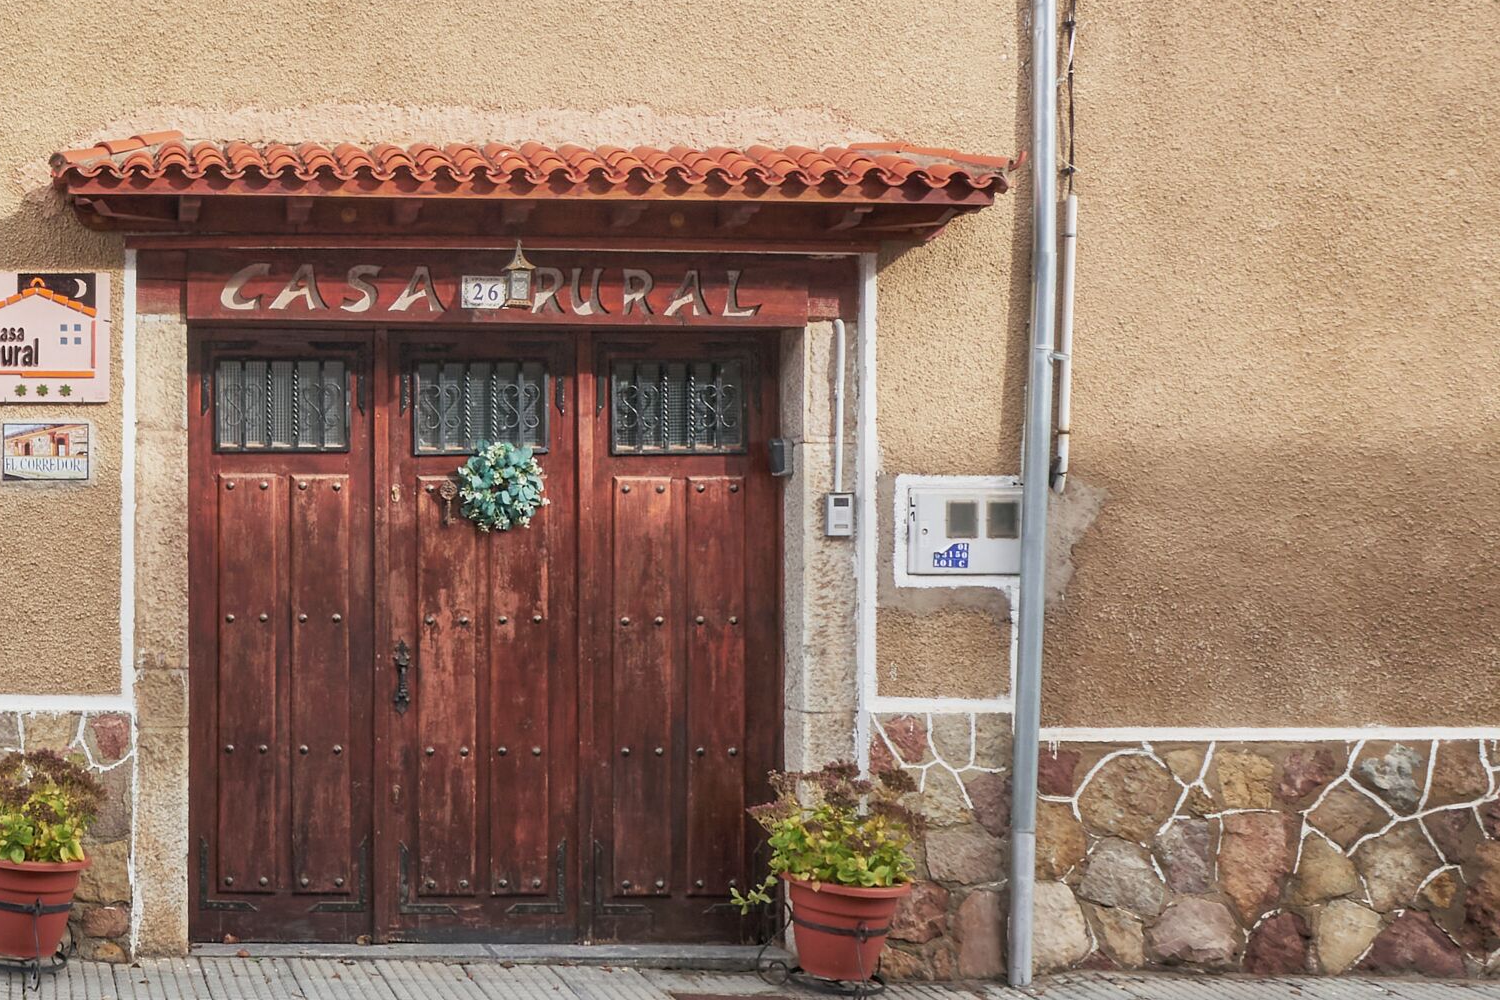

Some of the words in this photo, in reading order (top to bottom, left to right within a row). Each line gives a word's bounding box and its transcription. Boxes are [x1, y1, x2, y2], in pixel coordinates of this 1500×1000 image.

[220, 263, 448, 312] CASA
[531, 266, 763, 317] RURAL
[472, 282, 499, 301] 26
[5, 458, 17, 471] EL
[20, 458, 82, 472] CORREDOR
